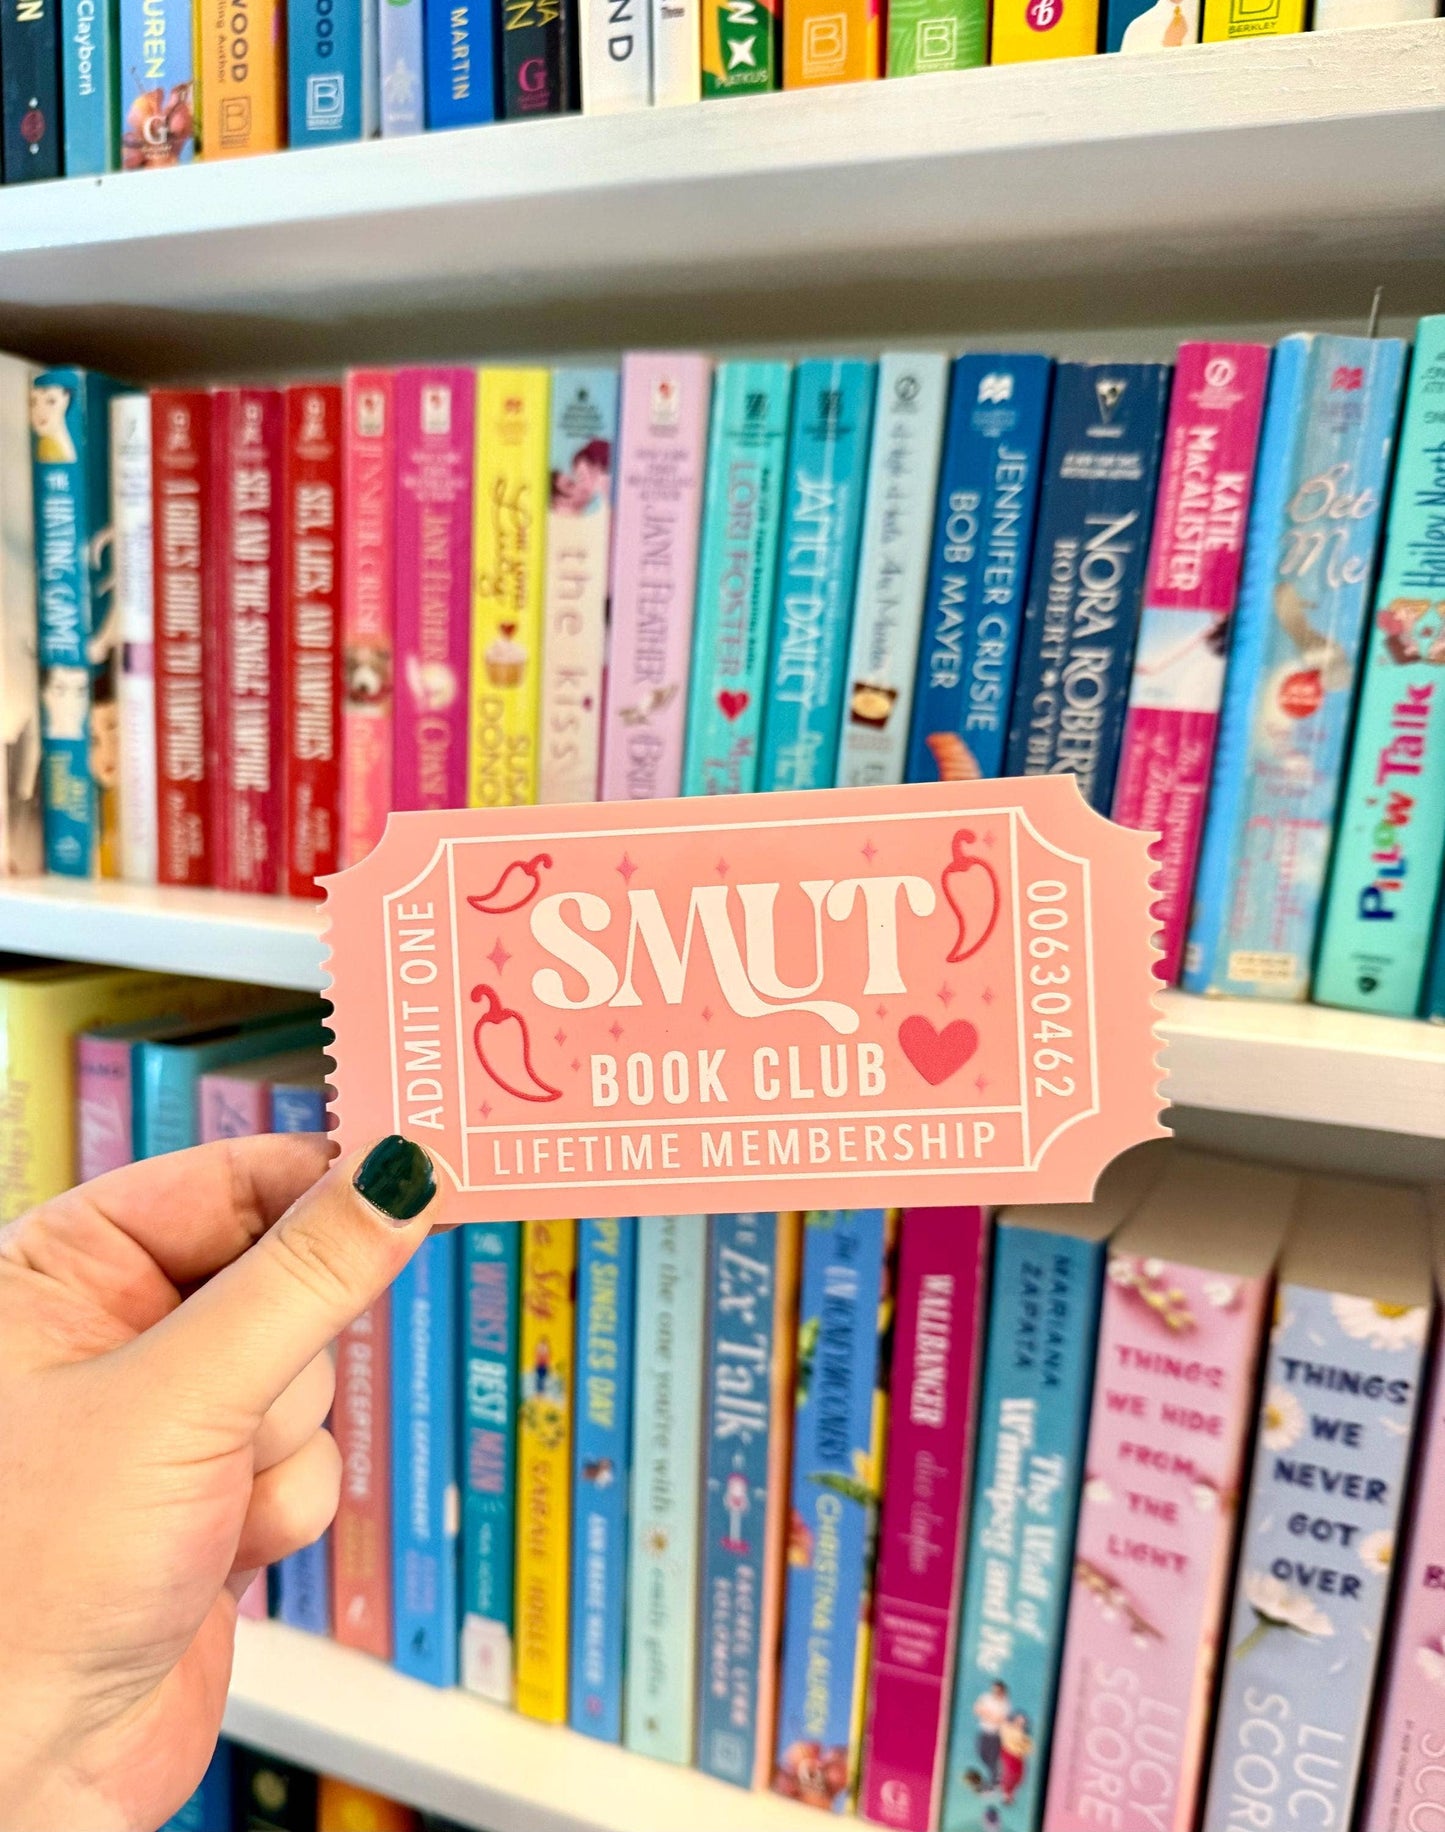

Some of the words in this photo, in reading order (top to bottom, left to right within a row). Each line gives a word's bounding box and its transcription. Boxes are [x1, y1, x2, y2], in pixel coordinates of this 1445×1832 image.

[451, 6, 470, 100] MARTIN
[1228, 21, 1277, 33] BERKLEY
[43, 498, 76, 585] HATING
[727, 462, 760, 541] LORI
[943, 489, 981, 563] BOB
[983, 443, 1029, 605] JENNIFER
[1205, 471, 1248, 553] KATIE
[555, 547, 588, 638] the
[1074, 509, 1140, 640] NORA
[1402, 514, 1445, 587] Hailey
[45, 586, 80, 666] GAME
[632, 582, 675, 684] FEATHER
[718, 550, 752, 678] FOSTER
[929, 573, 968, 690] MAYER
[1040, 537, 1078, 667] ROBERT
[966, 615, 1011, 732] CRUSIE
[478, 697, 504, 808] DONO
[1048, 645, 1114, 798] ROBER
[1375, 683, 1435, 787] Talk
[507, 733, 531, 807] SUSA
[627, 735, 663, 799] BRID
[397, 901, 439, 985] ONE
[529, 875, 936, 1035] SMUT
[1026, 879, 1075, 1098] 00630462
[402, 1001, 444, 1131] ADMIT
[590, 1049, 730, 1108] BOOK
[752, 1042, 887, 1101] CLUB
[493, 1132, 680, 1176] LIFETIME
[701, 1121, 996, 1169] MEMBERSHIP
[468, 1261, 509, 1355] WORST
[588, 1260, 618, 1371] SINGLES
[658, 1262, 680, 1304] the
[718, 1246, 771, 1324] Ex
[1015, 1260, 1043, 1371] ZAPATA
[1043, 1253, 1071, 1388] MARIANA
[655, 1310, 673, 1360] one
[909, 1273, 956, 1430] WALLBANGER
[1116, 1345, 1226, 1390] THINGS
[347, 1342, 374, 1498] DECEPTION
[467, 1356, 508, 1427] BEST
[587, 1375, 616, 1429] DAY
[714, 1332, 769, 1444] Talk
[1105, 1391, 1147, 1418] WE
[1162, 1405, 1225, 1437] HIDE
[1280, 1356, 1412, 1406] THINGS
[468, 1426, 508, 1495] MAN
[1118, 1442, 1196, 1477] FROM
[1311, 1414, 1365, 1449] WE
[980, 1397, 1039, 1557] Winnipeg
[1029, 1450, 1066, 1516] The
[1127, 1491, 1180, 1523] THE
[1273, 1457, 1389, 1505] NEVER
[811, 1492, 844, 1630] CHRISTINA
[1018, 1523, 1058, 1600] Wall
[1107, 1534, 1190, 1575] LIGHT
[1286, 1511, 1360, 1548] GOT
[733, 1564, 755, 1658] RACHEL
[981, 1558, 1012, 1626] and
[1269, 1557, 1364, 1601] OVER
[711, 1576, 732, 1698] SOLOMON
[804, 1635, 833, 1736] LAUREN
[1077, 1663, 1141, 1829] SCORE
[1128, 1697, 1184, 1832] LUCY
[1287, 1723, 1348, 1832] LUC
